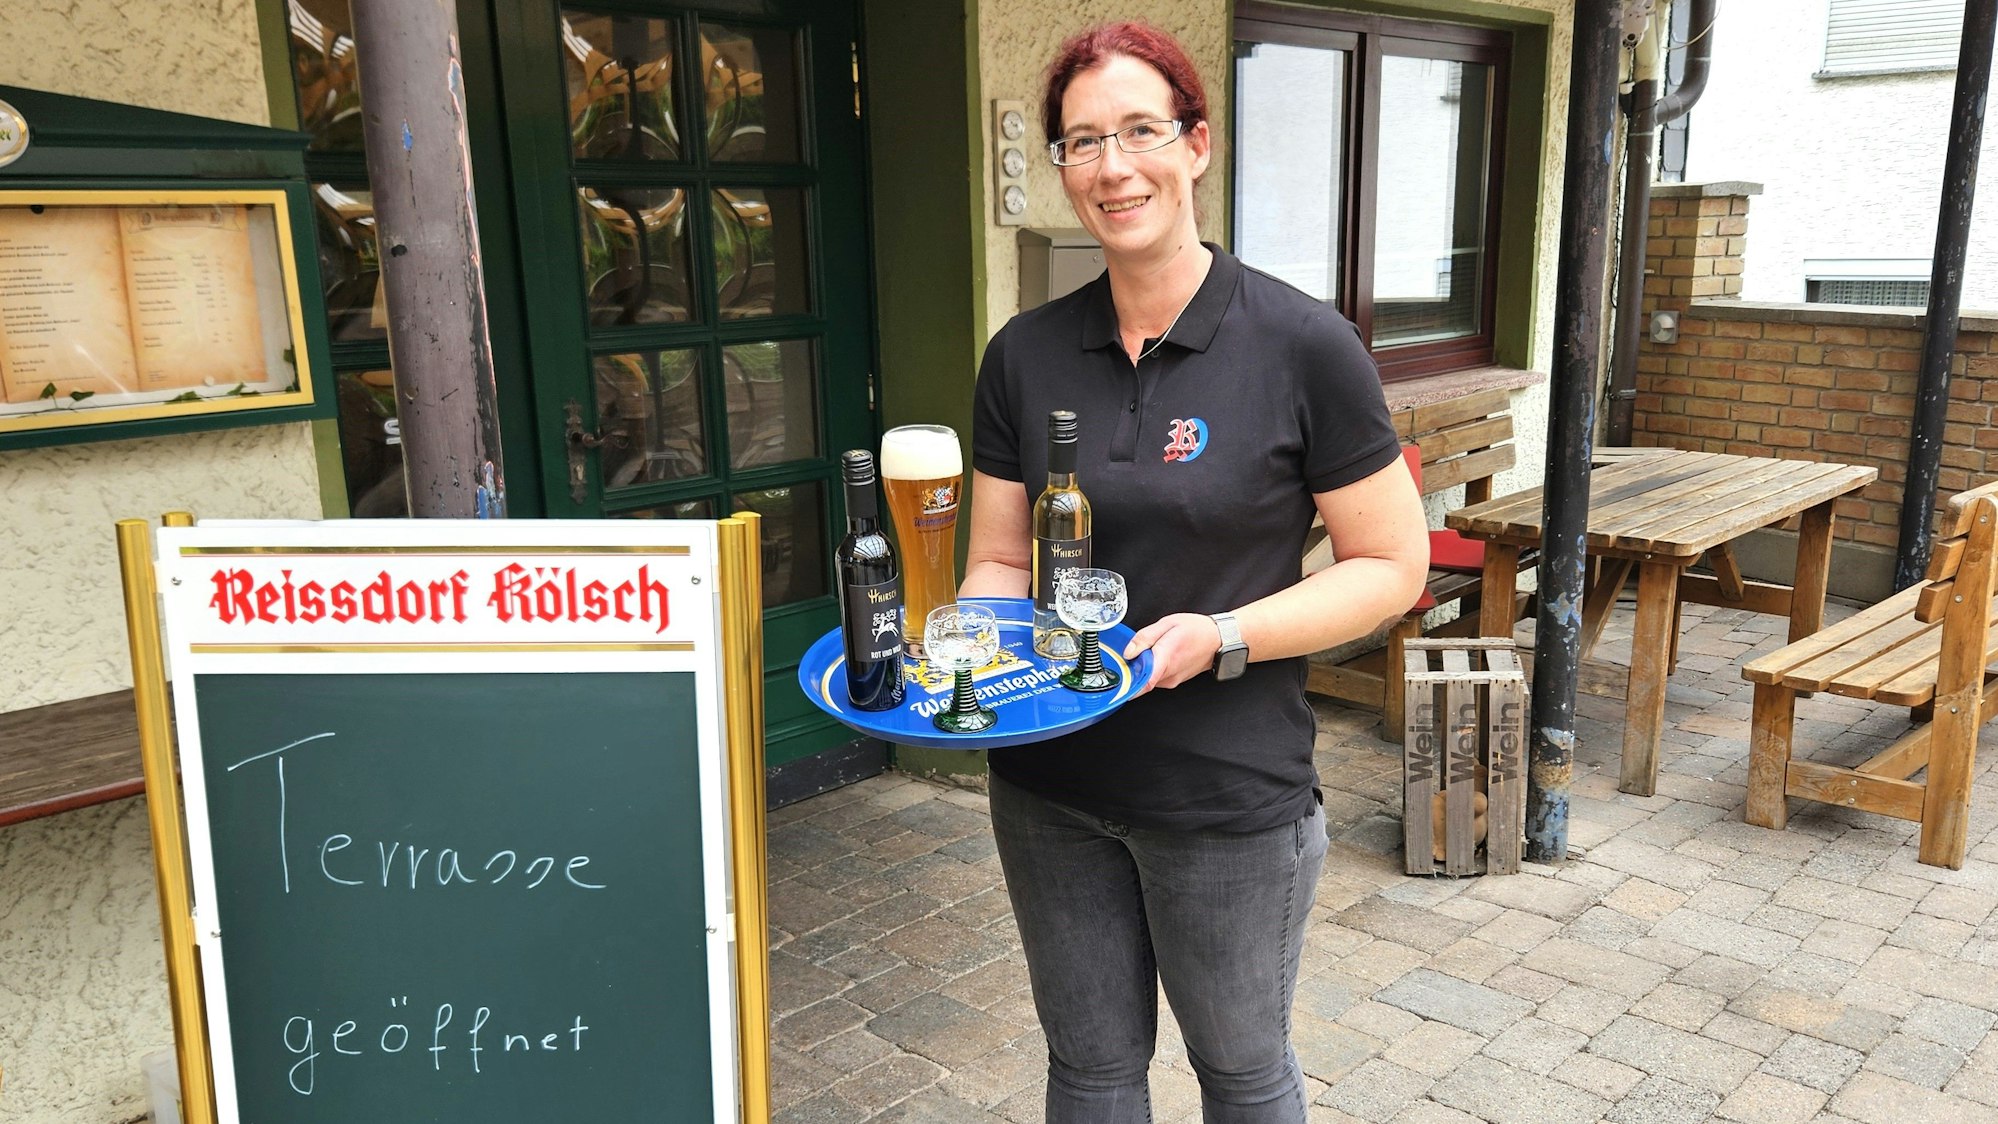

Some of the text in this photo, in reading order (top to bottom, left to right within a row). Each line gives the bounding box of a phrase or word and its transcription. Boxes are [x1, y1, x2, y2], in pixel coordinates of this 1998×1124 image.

[208, 562, 670, 634] Reissdorf Kölsch
[870, 650, 882, 659] ROT
[882, 648, 893, 658] UND
[909, 664, 1073, 719] Weienstephan
[985, 691, 1034, 709] BRAUEREI
[1032, 685, 1056, 695] DER
[1408, 703, 1433, 784] Wein
[1450, 703, 1476, 784] Wein
[1491, 702, 1520, 784] Wein
[227, 732, 606, 893] Terrasse
[283, 996, 588, 1095] geöffnet
